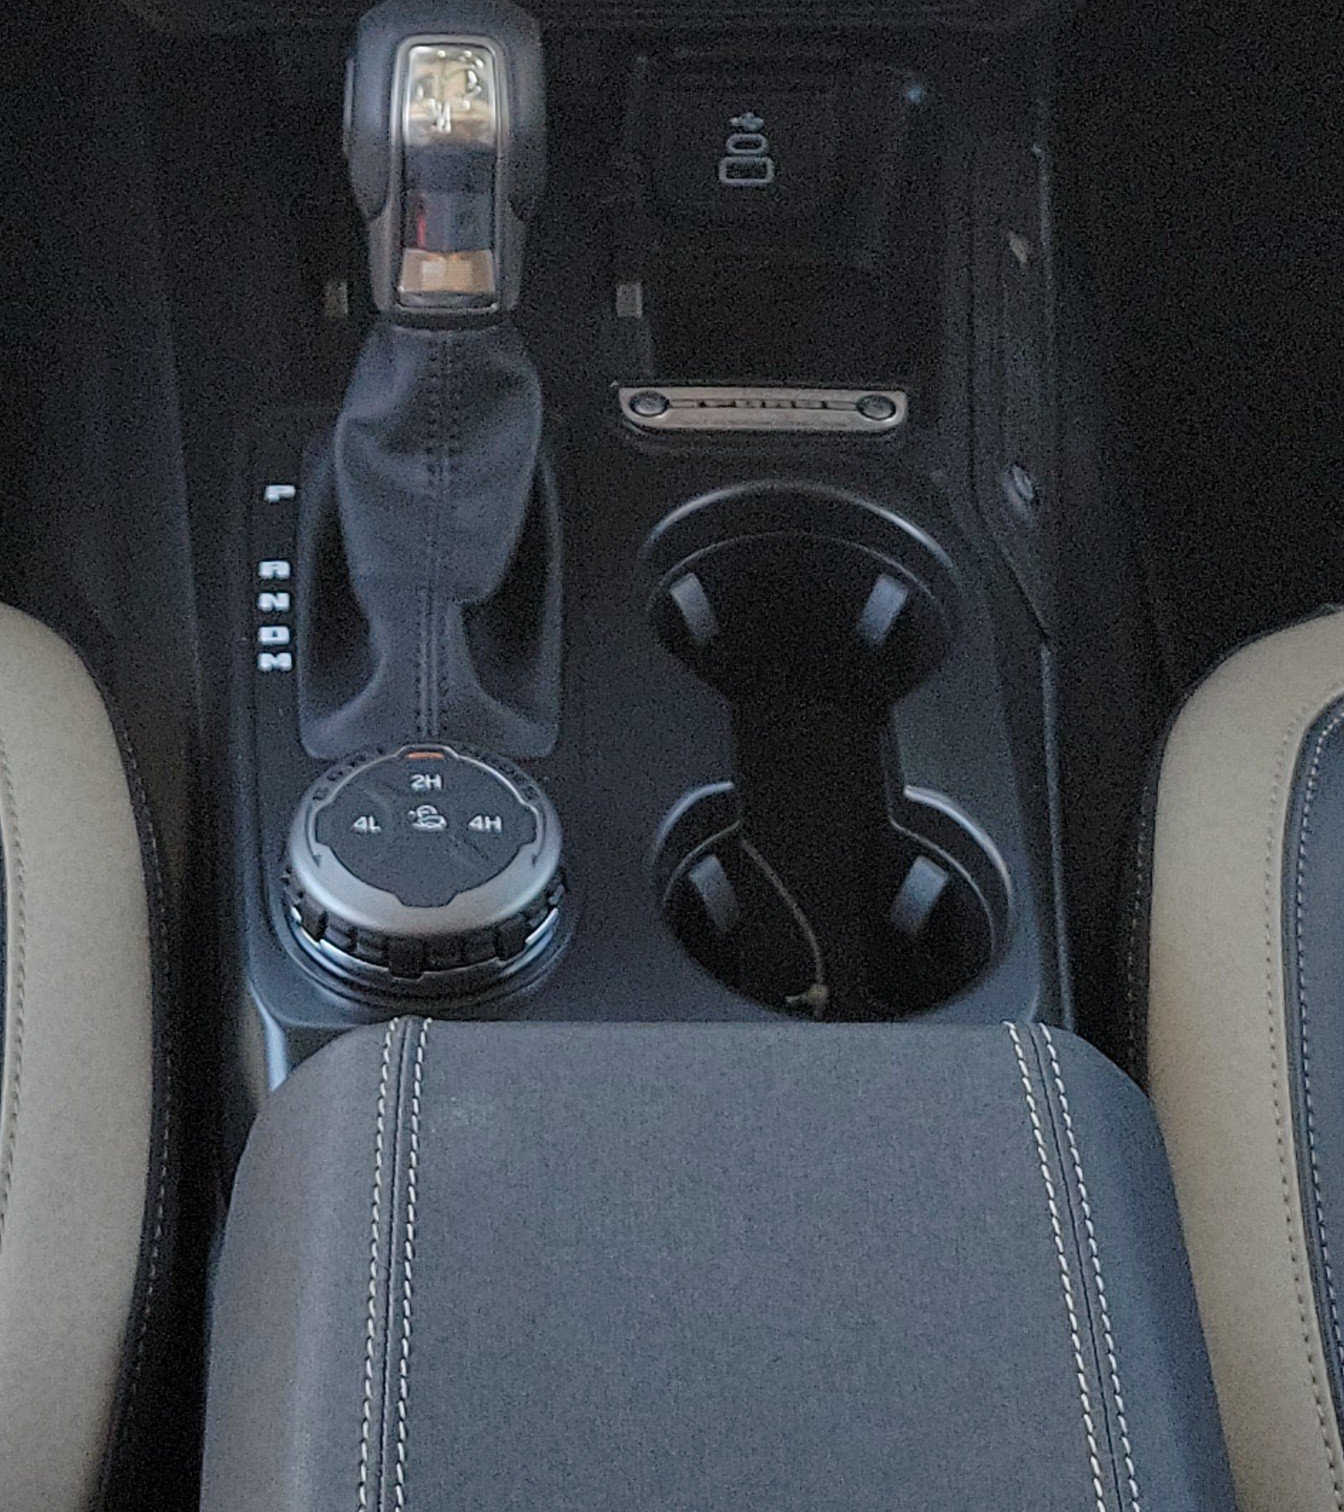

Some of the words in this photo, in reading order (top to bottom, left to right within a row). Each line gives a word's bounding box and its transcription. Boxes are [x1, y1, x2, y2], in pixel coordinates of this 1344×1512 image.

[410, 773, 442, 790] 2H
[353, 815, 381, 833] 4L
[468, 815, 502, 833] 4H
